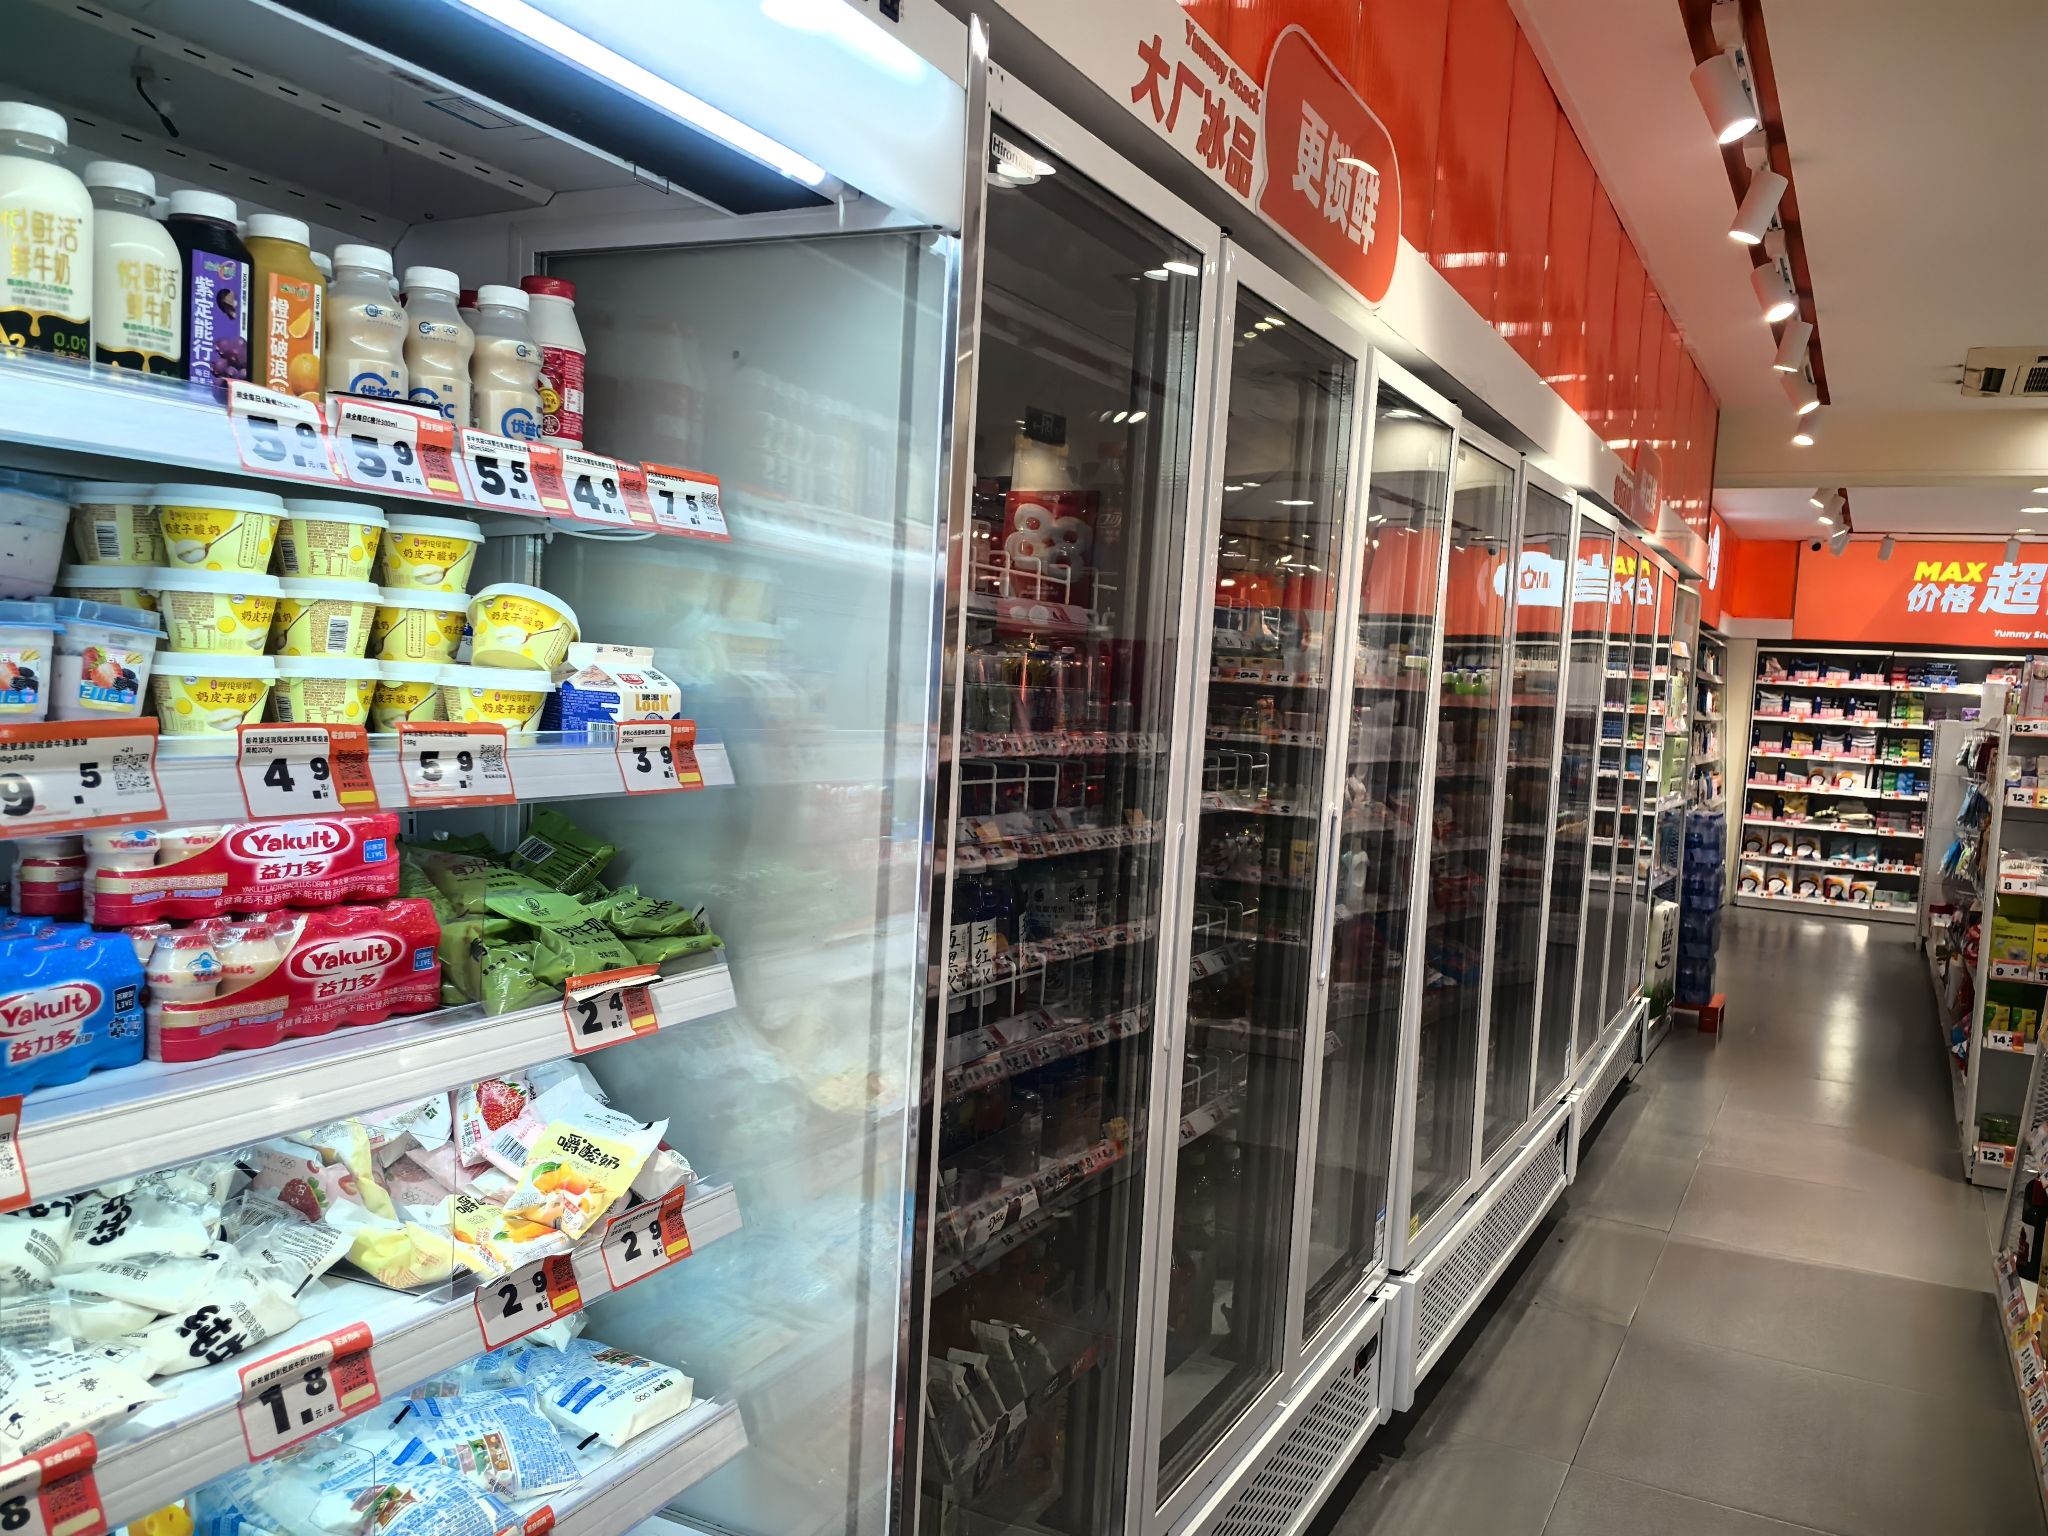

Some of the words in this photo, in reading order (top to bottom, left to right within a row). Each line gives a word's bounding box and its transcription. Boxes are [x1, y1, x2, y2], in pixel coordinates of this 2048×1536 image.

[1185, 19, 1230, 85] Yummy
[1228, 67, 1261, 115] Snack
[1132, 35, 1256, 199] 大厂冰品
[1292, 99, 1380, 256] 更锁鲜
[10, 241, 71, 286] 鲜牛奶
[269, 297, 289, 378] 橙风破浪
[247, 415, 317, 466] 5.9
[351, 434, 413, 482] 5.9
[475, 456, 528, 499] 5.5
[573, 475, 618, 513] 4.9
[658, 490, 699, 524] 7.5
[403, 548, 458, 562] 奶皮子酸奶
[1914, 561, 1988, 582] MAX
[1907, 583, 1976, 613] 价格
[491, 611, 545, 630] 奶皮子酸奶
[1994, 630, 2031, 639] Yummy
[196, 691, 257, 704] 奶皮子酸奶
[482, 703, 535, 715] 奶皮子酸奶
[264, 757, 330, 799] 4.9
[420, 750, 473, 788] 5.9
[632, 746, 673, 778] 3.9
[250, 825, 333, 852] Yakult
[366, 850, 384, 860] LIVE
[260, 860, 324, 880] 益力多
[309, 944, 388, 969] Yakult
[415, 959, 432, 969] LIVE
[317, 974, 377, 998] 益力多
[0, 993, 86, 1027] Yakult
[116, 999, 133, 1010] LIVE
[577, 992, 623, 1035] 2.4
[10, 1029, 76, 1062] 益力多
[556, 1132, 620, 1171] 嚼酸奶
[621, 1220, 662, 1262] 2.9
[498, 1271, 548, 1318] 2.9
[259, 1366, 327, 1435] 1.8
